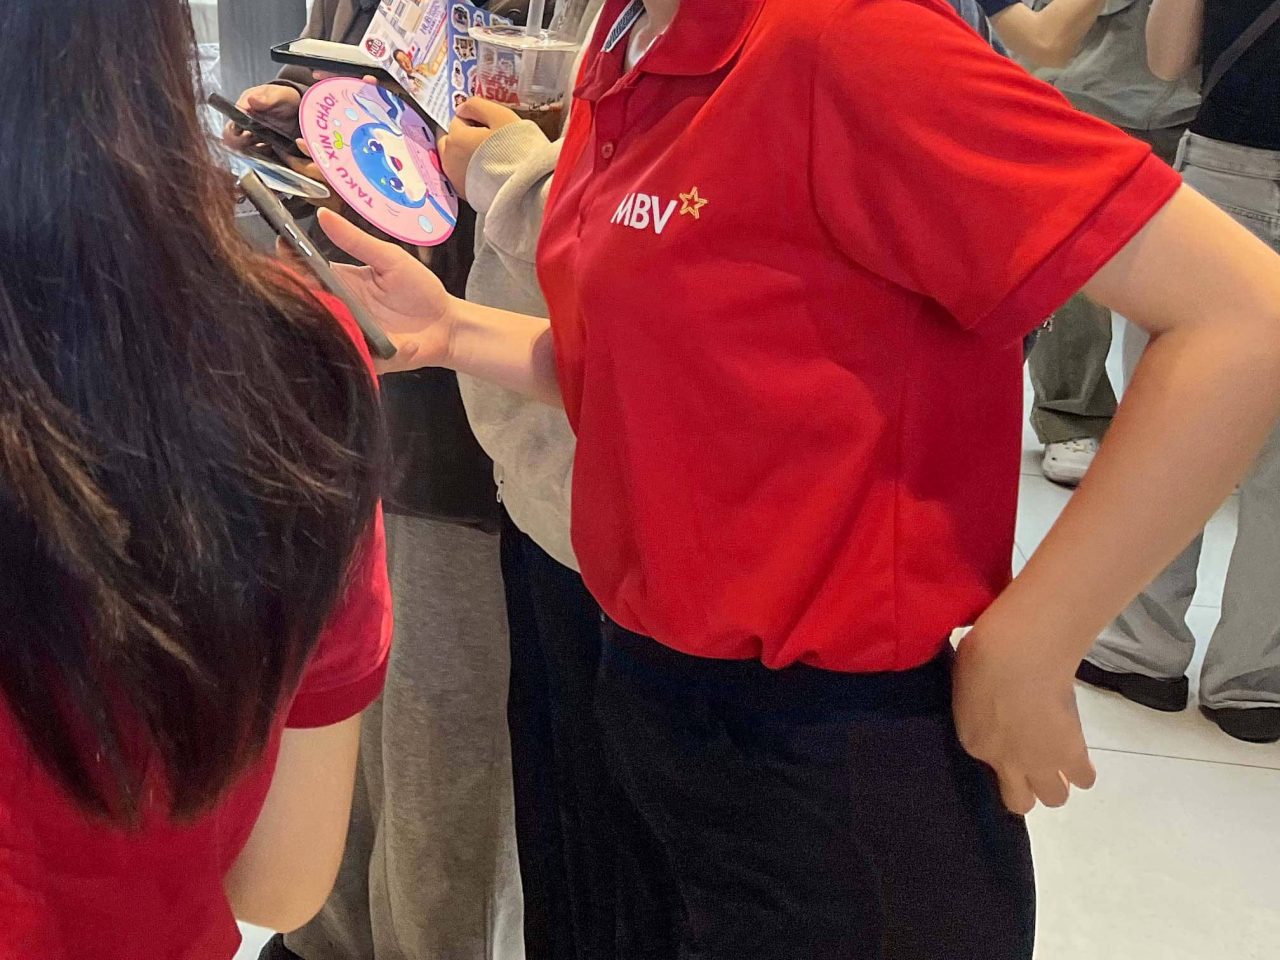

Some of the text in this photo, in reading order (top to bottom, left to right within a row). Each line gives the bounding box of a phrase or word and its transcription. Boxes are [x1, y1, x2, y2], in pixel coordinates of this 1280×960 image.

[319, 134, 339, 160] XIN
[336, 167, 374, 208] TAKU
[610, 192, 679, 235] MBV
